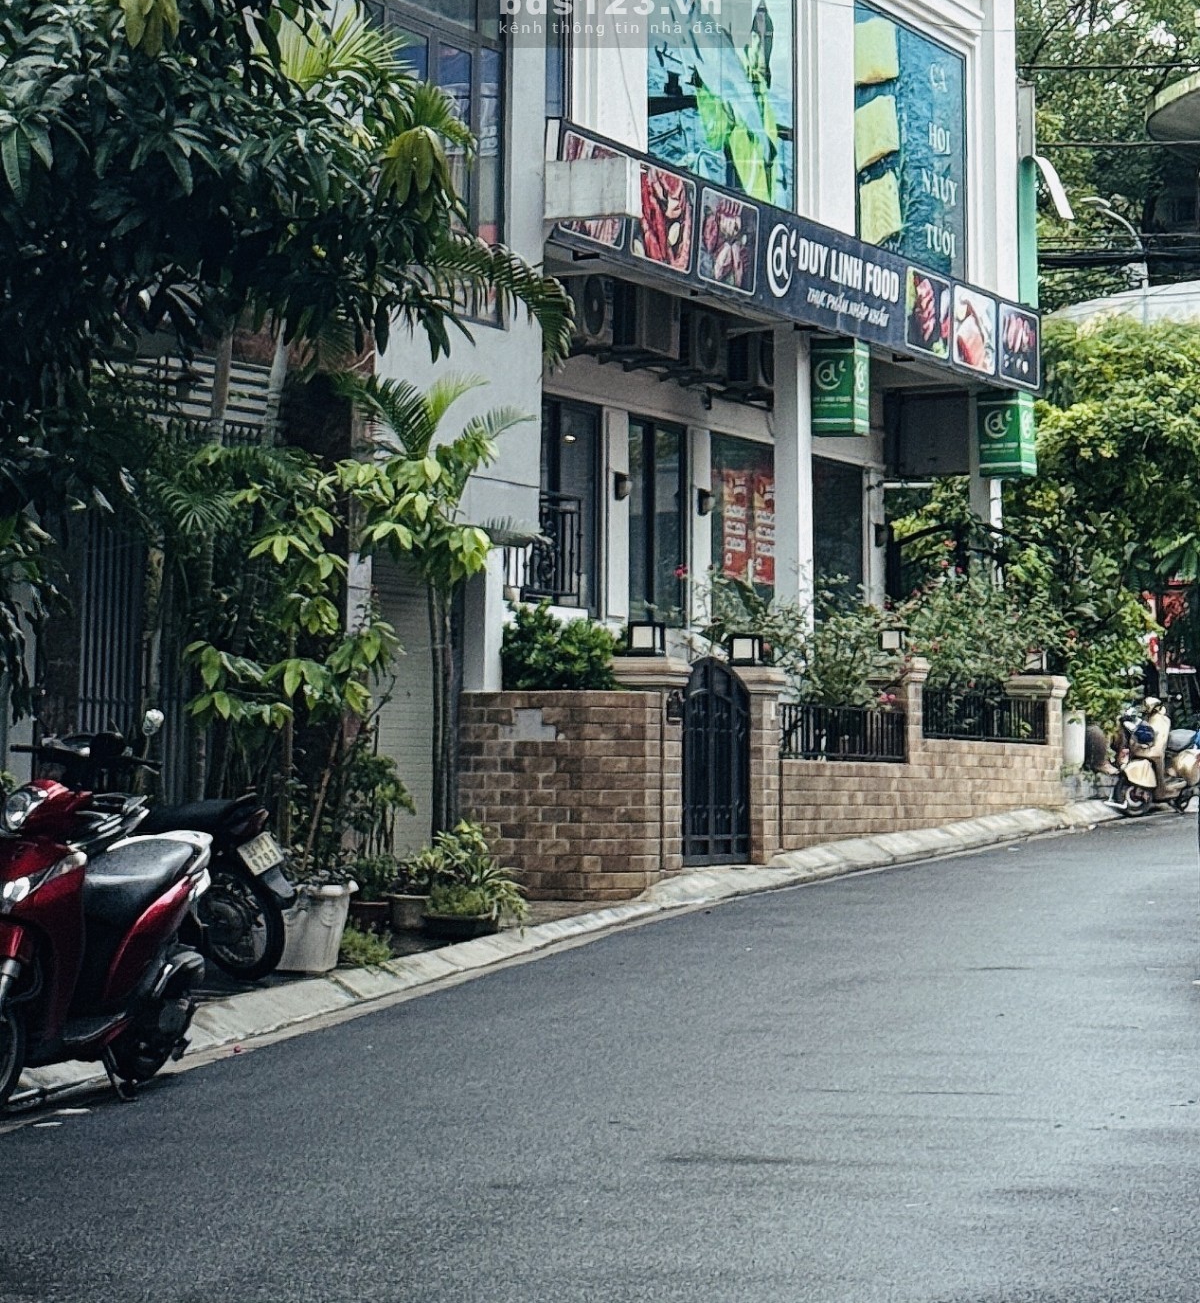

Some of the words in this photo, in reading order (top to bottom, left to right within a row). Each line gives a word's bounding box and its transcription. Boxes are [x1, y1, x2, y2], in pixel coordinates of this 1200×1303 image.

[798, 237, 829, 278] DUY
[829, 249, 863, 290] LINH
[864, 262, 901, 304] FOOD
